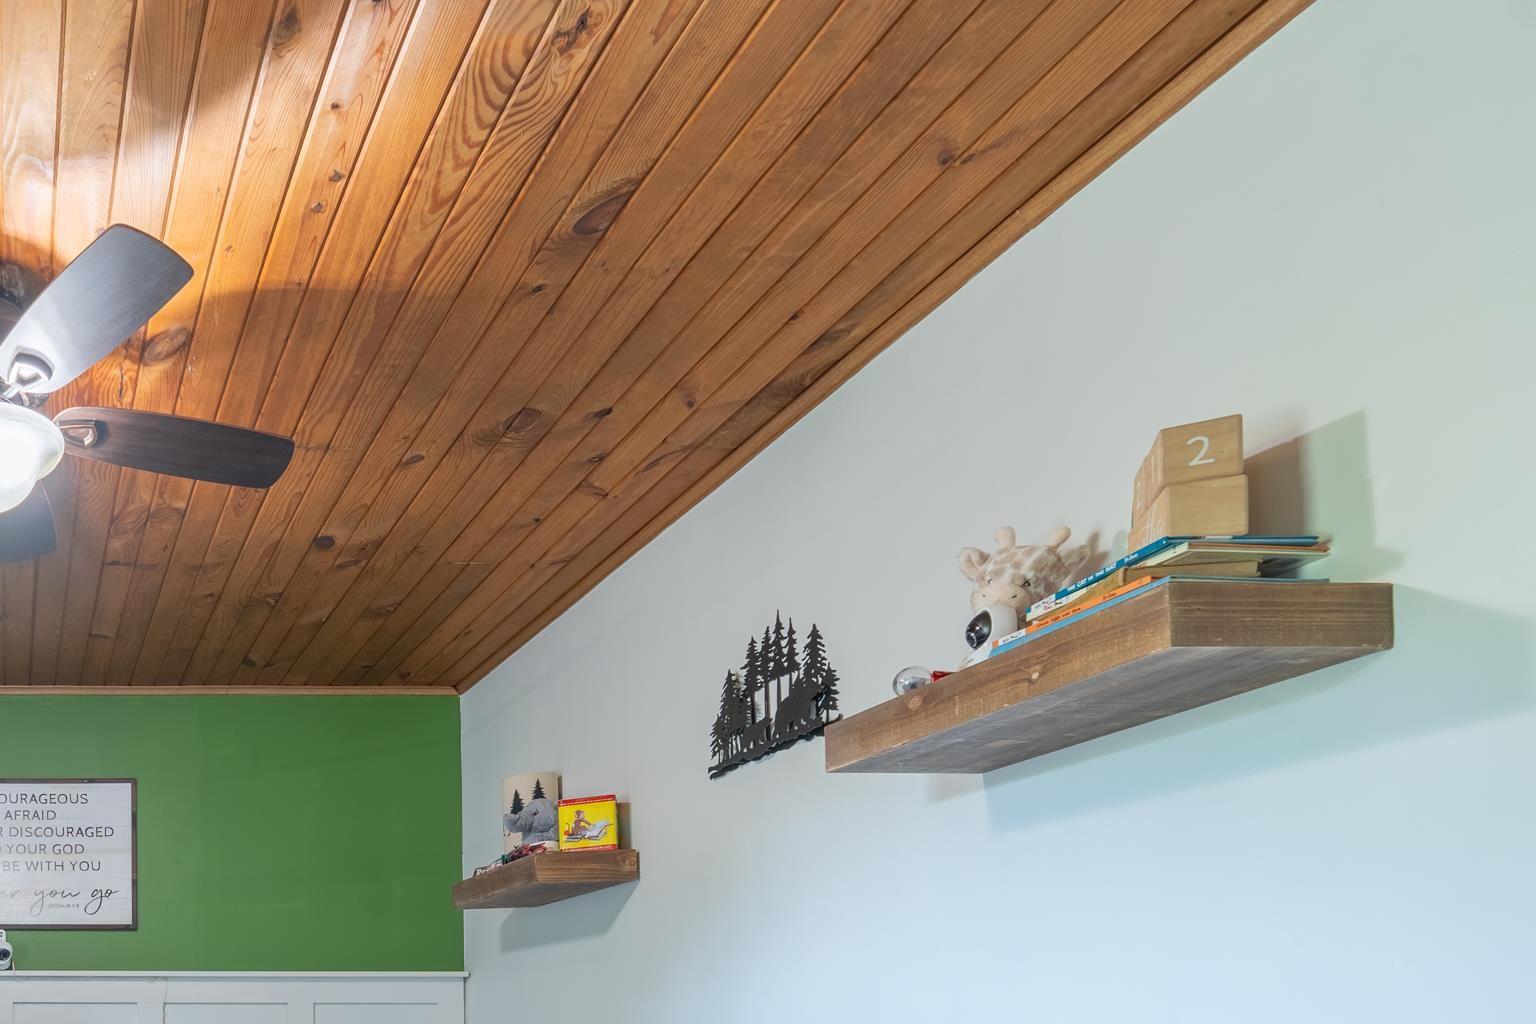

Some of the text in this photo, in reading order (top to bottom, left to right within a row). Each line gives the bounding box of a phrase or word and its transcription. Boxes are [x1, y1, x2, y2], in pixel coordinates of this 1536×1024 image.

[1186, 435, 1215, 466] 2
[1077, 577, 1087, 586] CAT
[4, 809, 57, 820] AFRAID
[9, 826, 114, 837] DISCOURAGED
[5, 843, 47, 854] YOUR
[52, 843, 85, 854] GOD
[3, 860, 20, 871] BE
[25, 860, 64, 871] WITH
[69, 860, 101, 871] YOU
[29, 889, 80, 917] you
[84, 888, 119, 915] go
